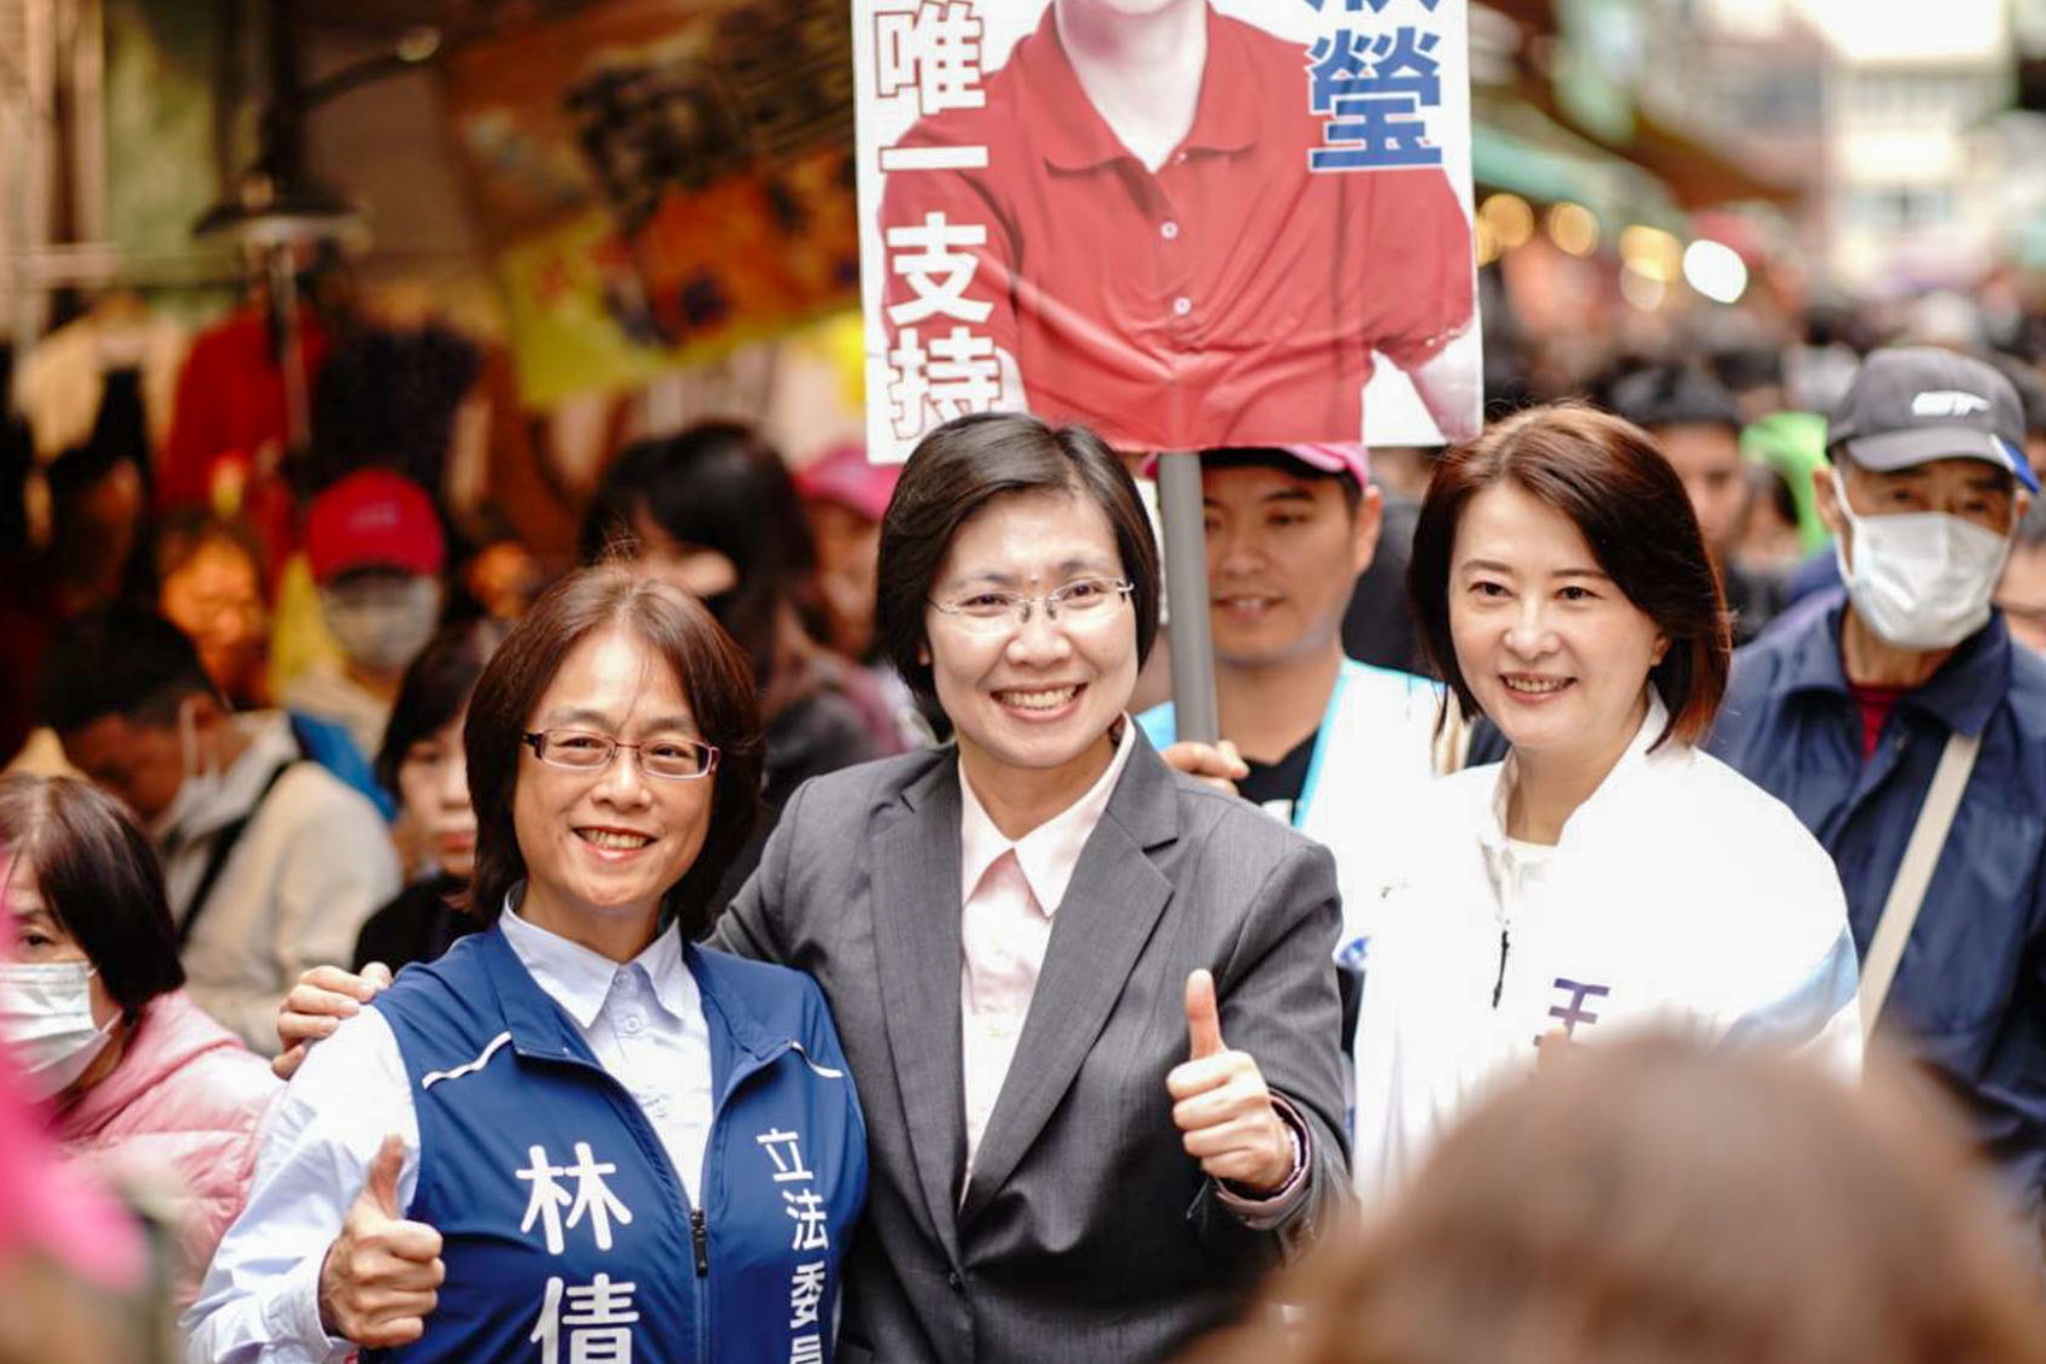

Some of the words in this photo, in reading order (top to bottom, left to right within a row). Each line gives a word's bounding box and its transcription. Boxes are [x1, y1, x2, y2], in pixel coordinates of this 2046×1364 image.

[874, 0, 1003, 441] 唯一支持
[1304, 0, 1444, 170] 瑩
